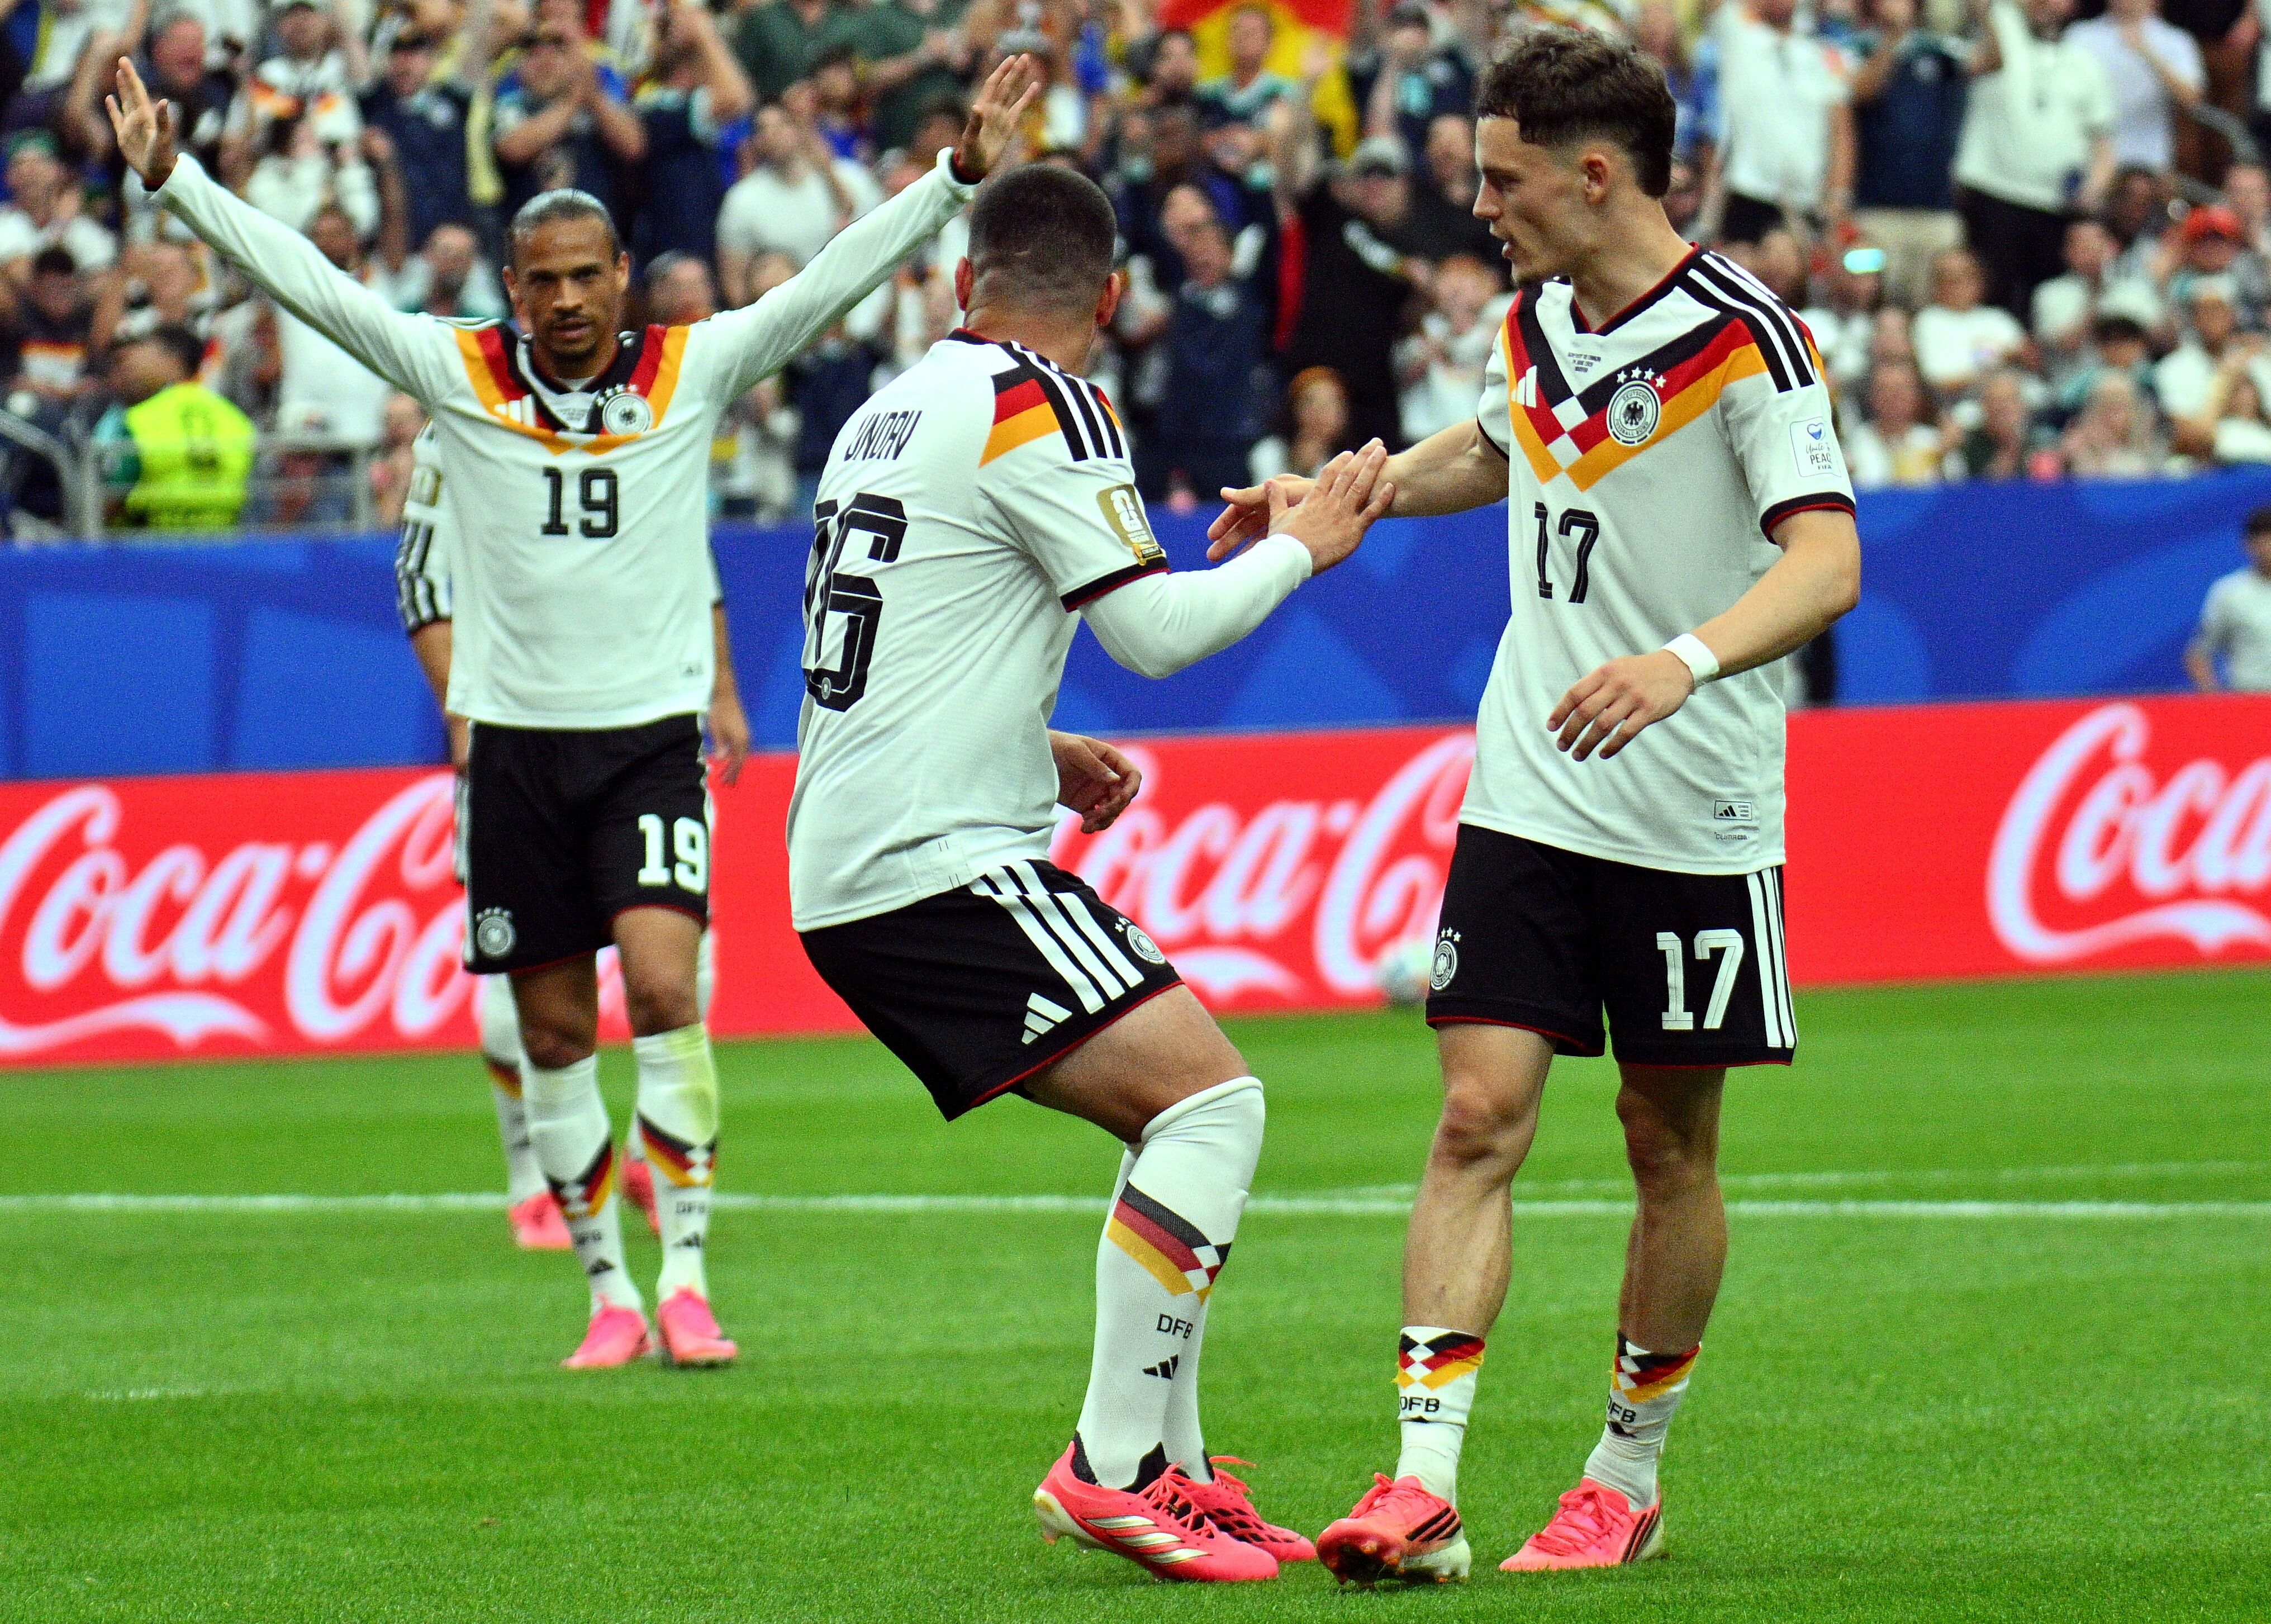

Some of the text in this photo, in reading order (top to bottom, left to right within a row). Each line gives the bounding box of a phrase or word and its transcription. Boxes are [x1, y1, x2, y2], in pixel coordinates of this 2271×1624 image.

[844, 410, 922, 462] UNDAV
[1810, 452, 1832, 464] PEAC
[541, 466, 619, 538] 19
[1534, 501, 1599, 604] 17
[638, 813, 709, 894] 19
[0, 772, 475, 1055] Coca-Co
[1656, 928, 1744, 1030] 17
[1156, 1313, 1194, 1339] DFB
[1399, 1396, 1440, 1412] DFB
